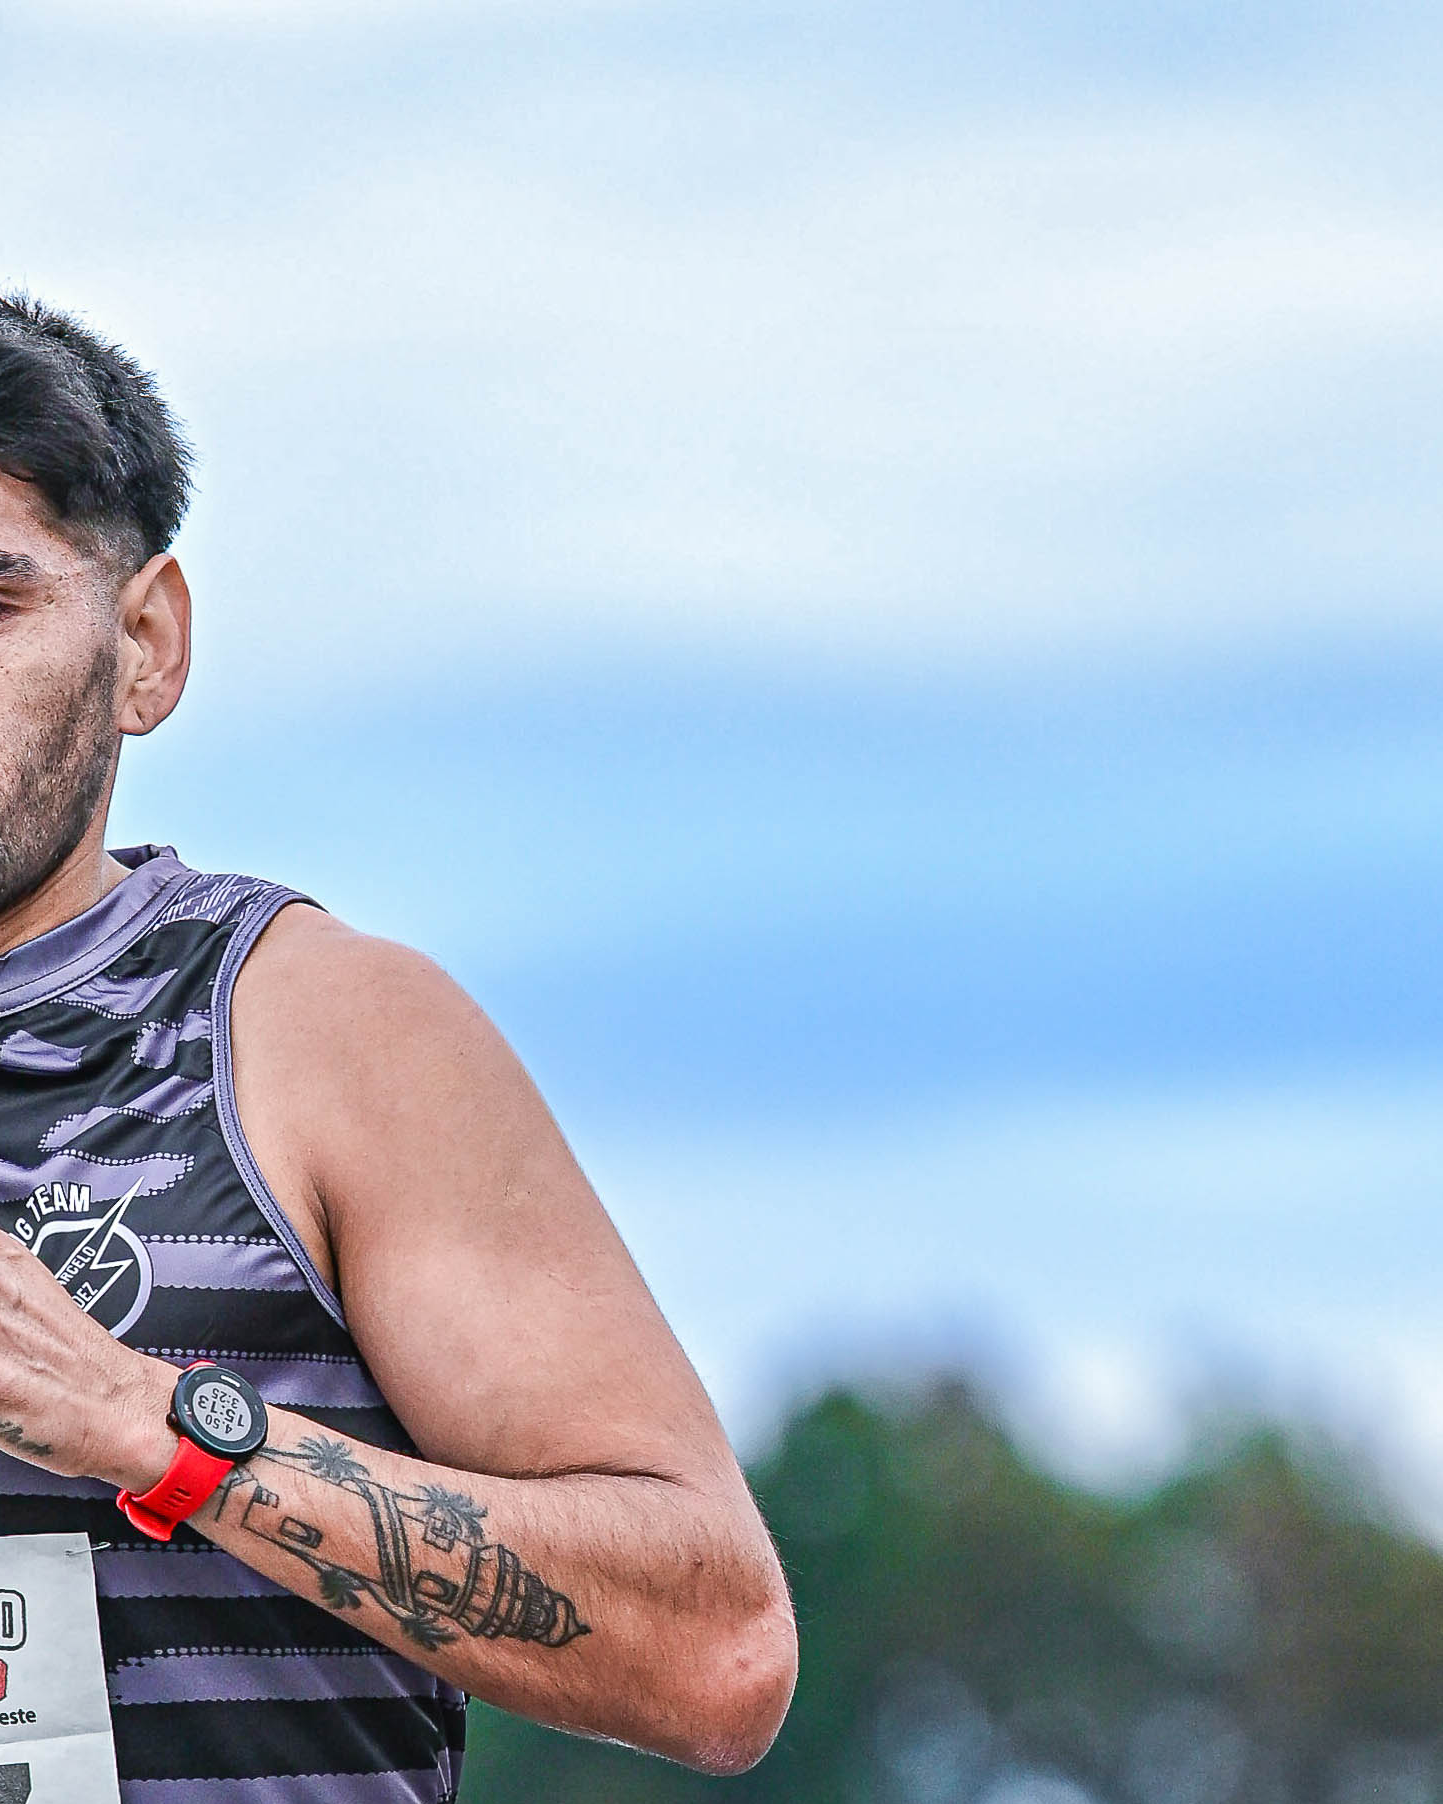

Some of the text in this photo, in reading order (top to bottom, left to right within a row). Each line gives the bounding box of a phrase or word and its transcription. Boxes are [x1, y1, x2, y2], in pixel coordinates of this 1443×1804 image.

[26, 1183, 90, 1222] TEAM
[197, 1395, 245, 1427] 15:13
[211, 1388, 240, 1409] 3:25
[205, 1414, 233, 1434] 4.50
